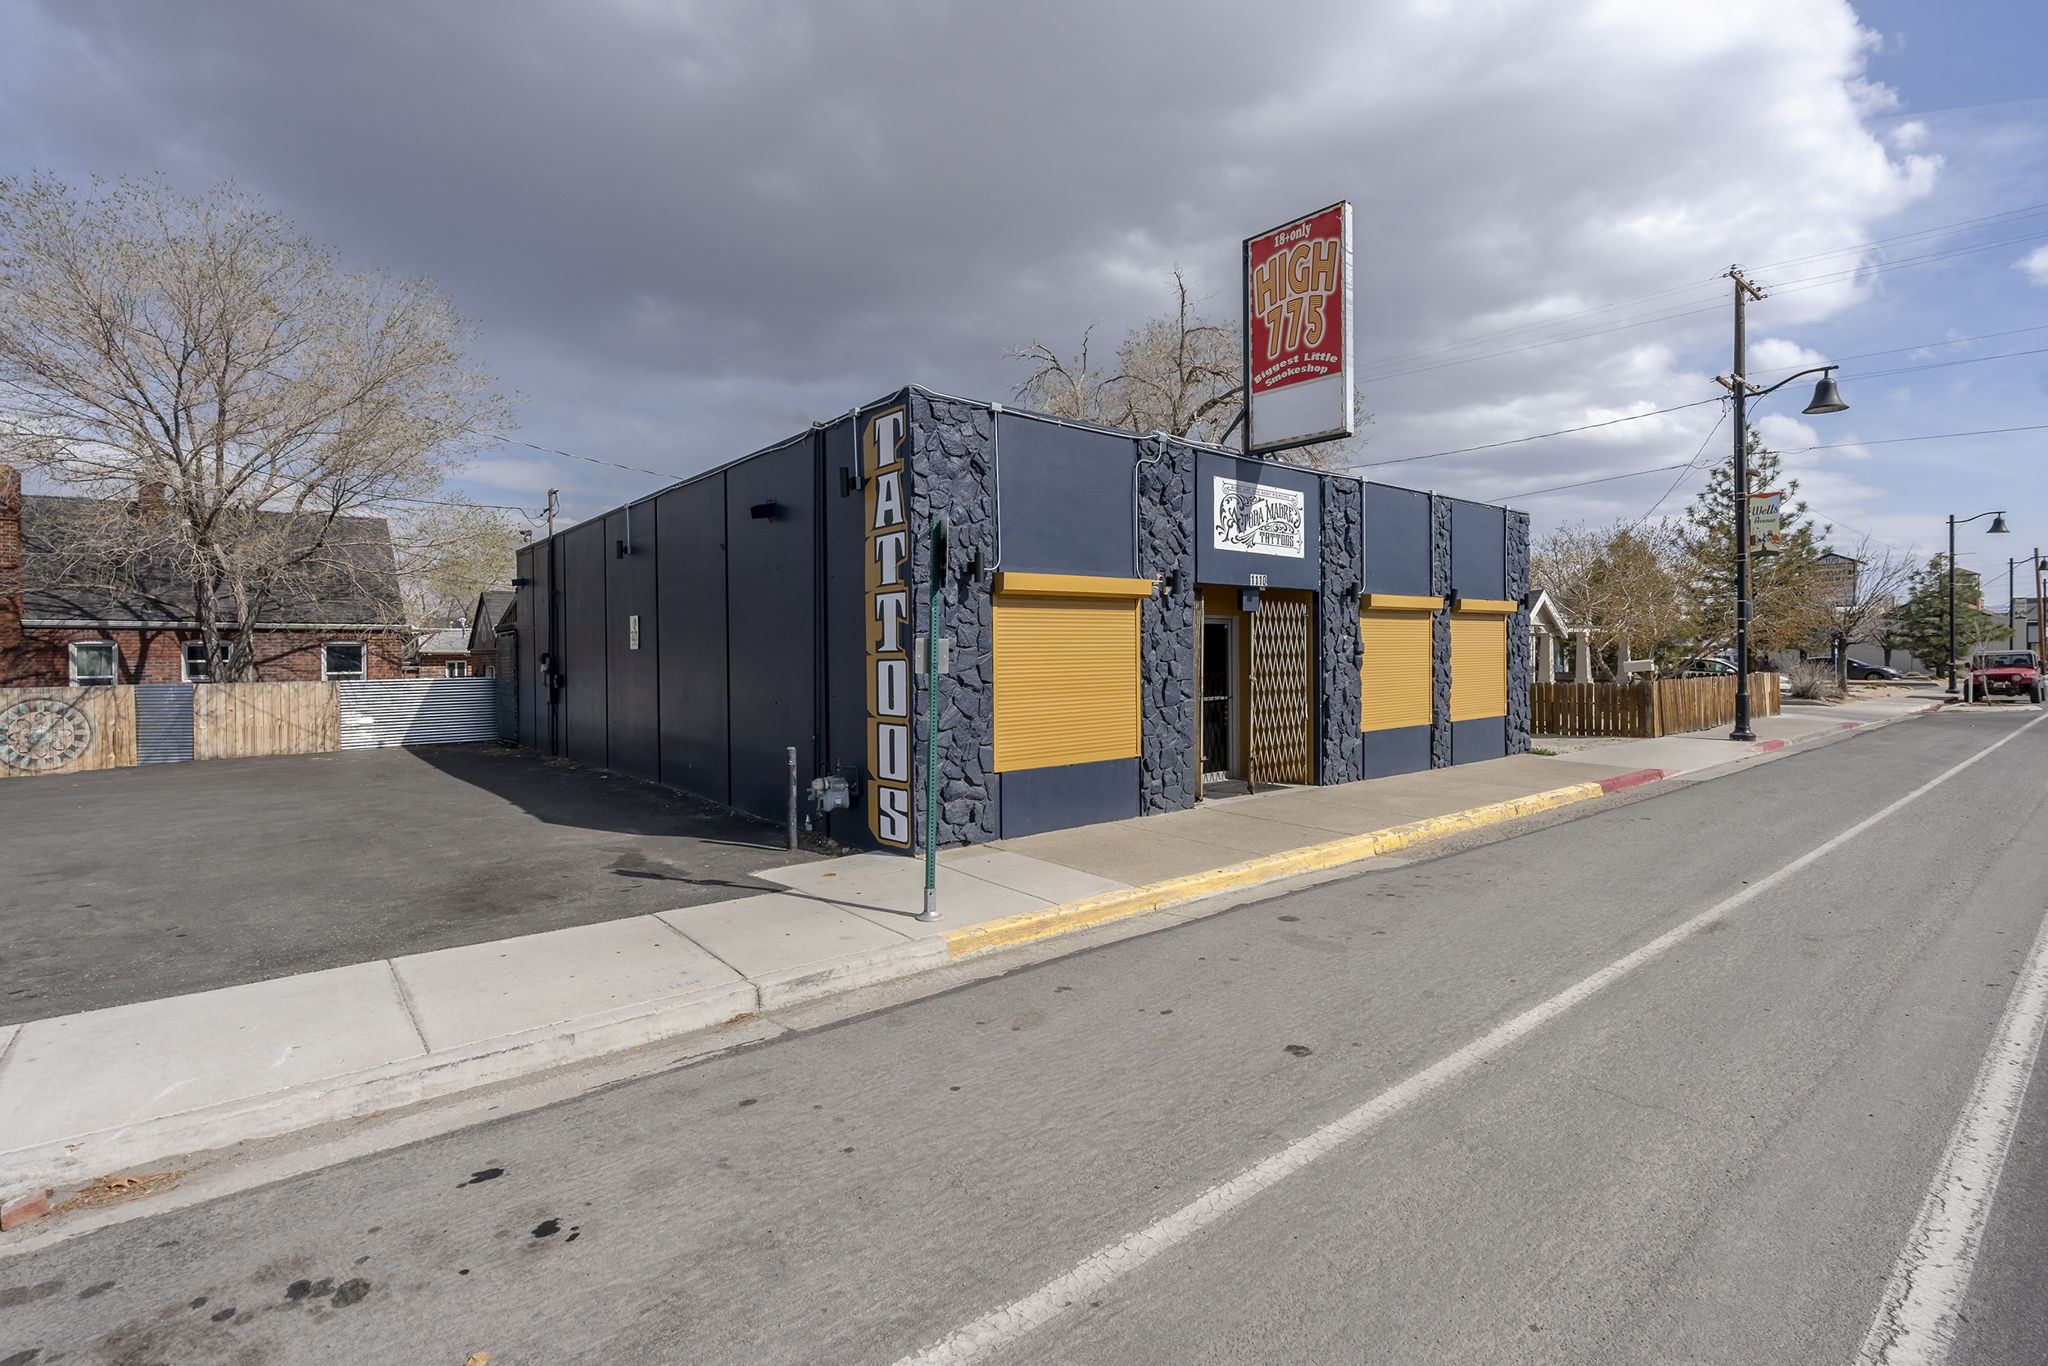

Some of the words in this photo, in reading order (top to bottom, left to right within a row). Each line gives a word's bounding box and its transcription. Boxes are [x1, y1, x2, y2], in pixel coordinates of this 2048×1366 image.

[1274, 222, 1312, 248] 18+only
[1255, 240, 1338, 315] HIGH
[1267, 294, 1323, 357] 775
[1253, 354, 1300, 384] Biggest
[1304, 351, 1338, 364] Little
[1264, 363, 1329, 387] Smokeshop
[1752, 504, 1779, 515] Wells
[1259, 532, 1294, 547] TATTOOS
[1251, 574, 1267, 586] 1110
[872, 409, 909, 844] TATTOOS
